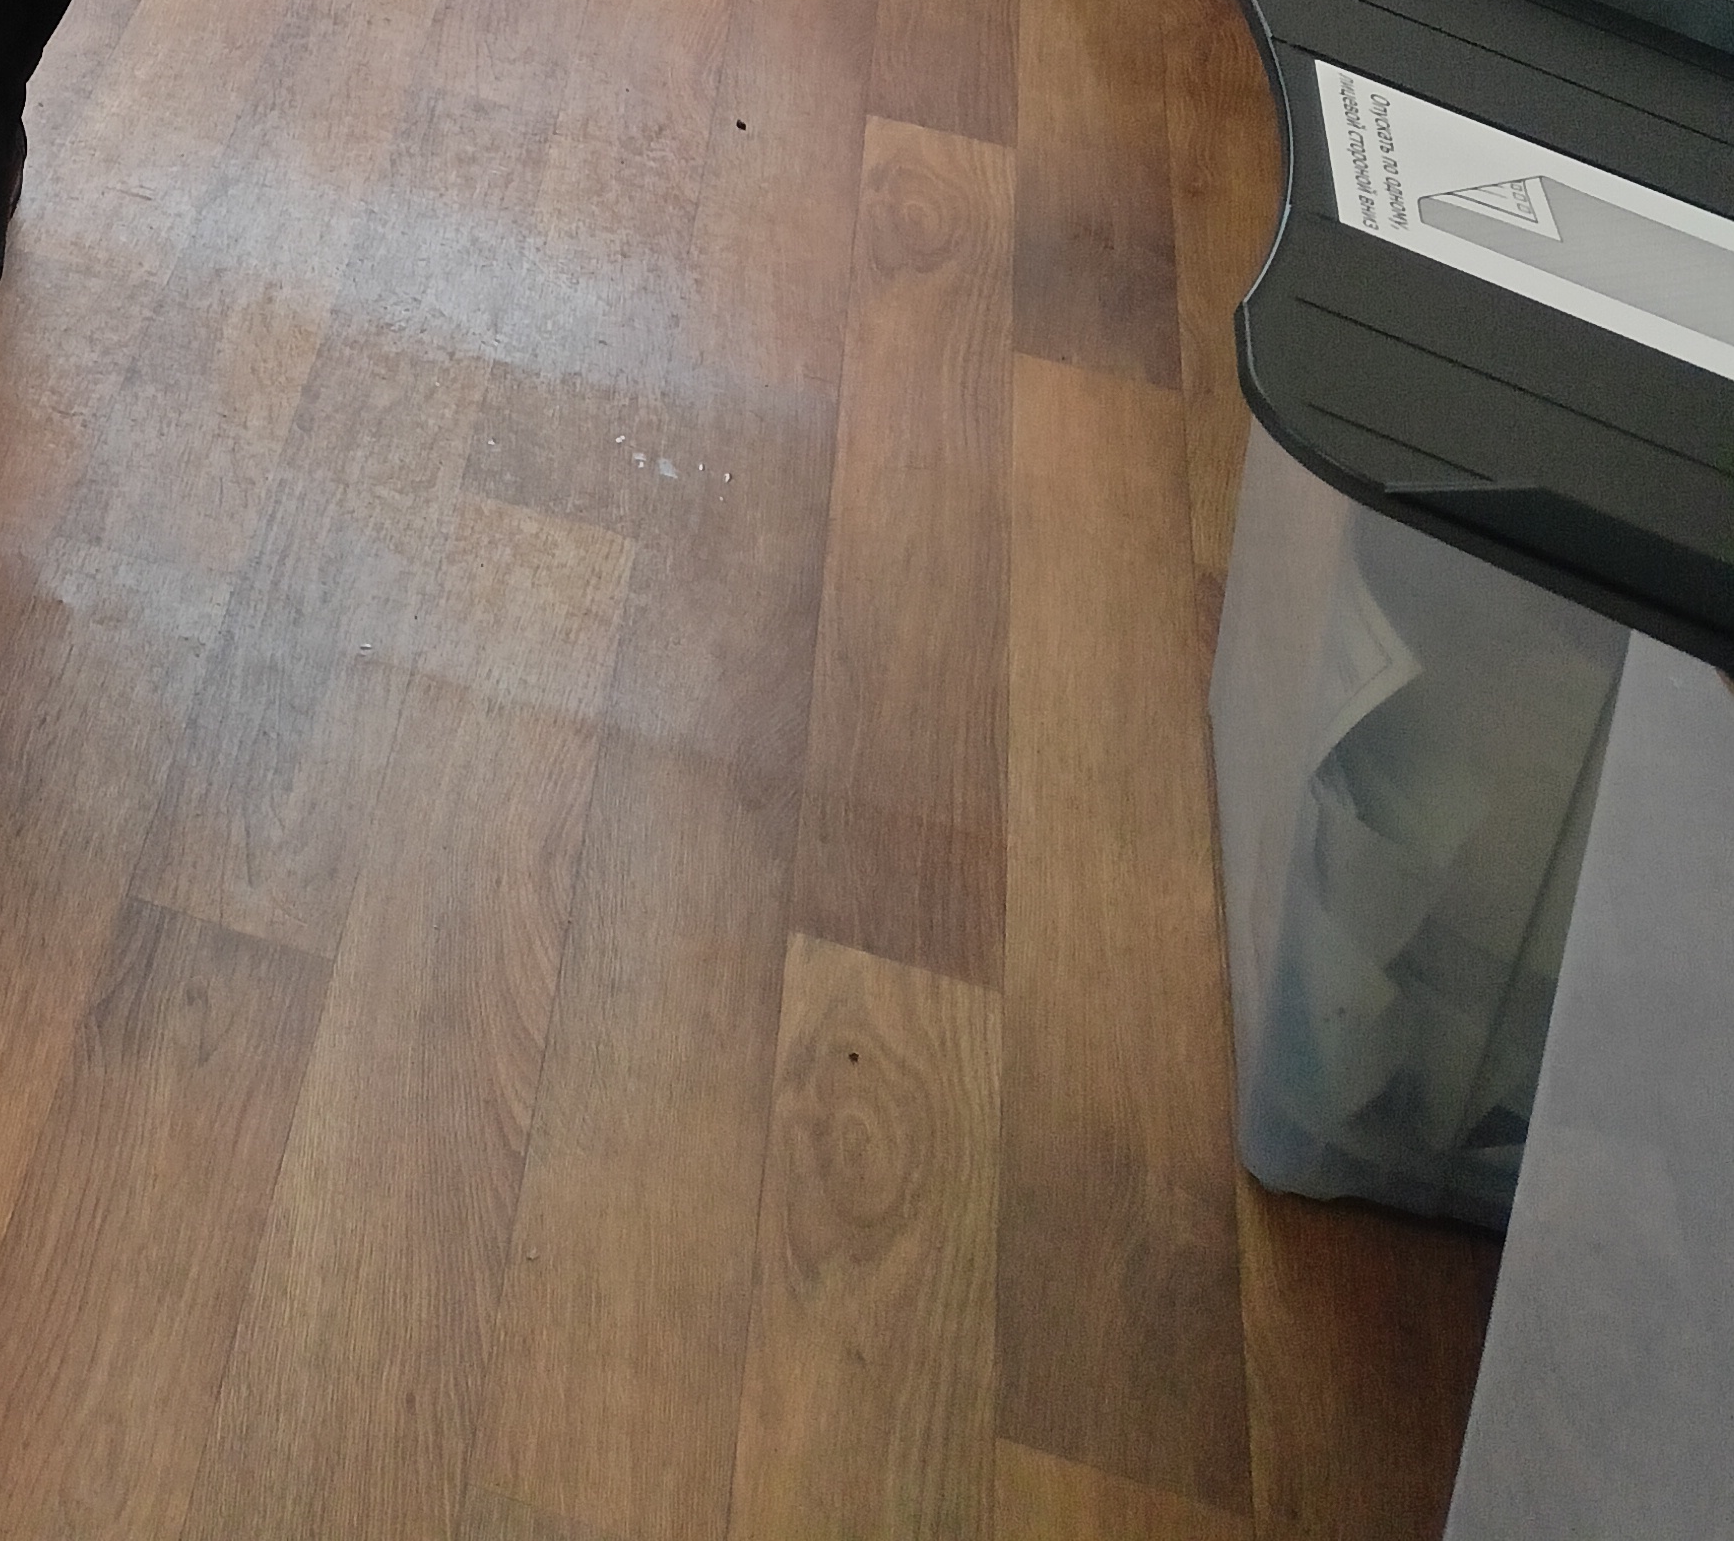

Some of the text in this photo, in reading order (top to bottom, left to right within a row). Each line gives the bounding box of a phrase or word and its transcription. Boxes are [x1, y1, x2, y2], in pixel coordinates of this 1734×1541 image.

[1338, 72, 1380, 231] лицевой стороной вниз
[1368, 93, 1395, 153] Опускать
[1382, 155, 1399, 175] по
